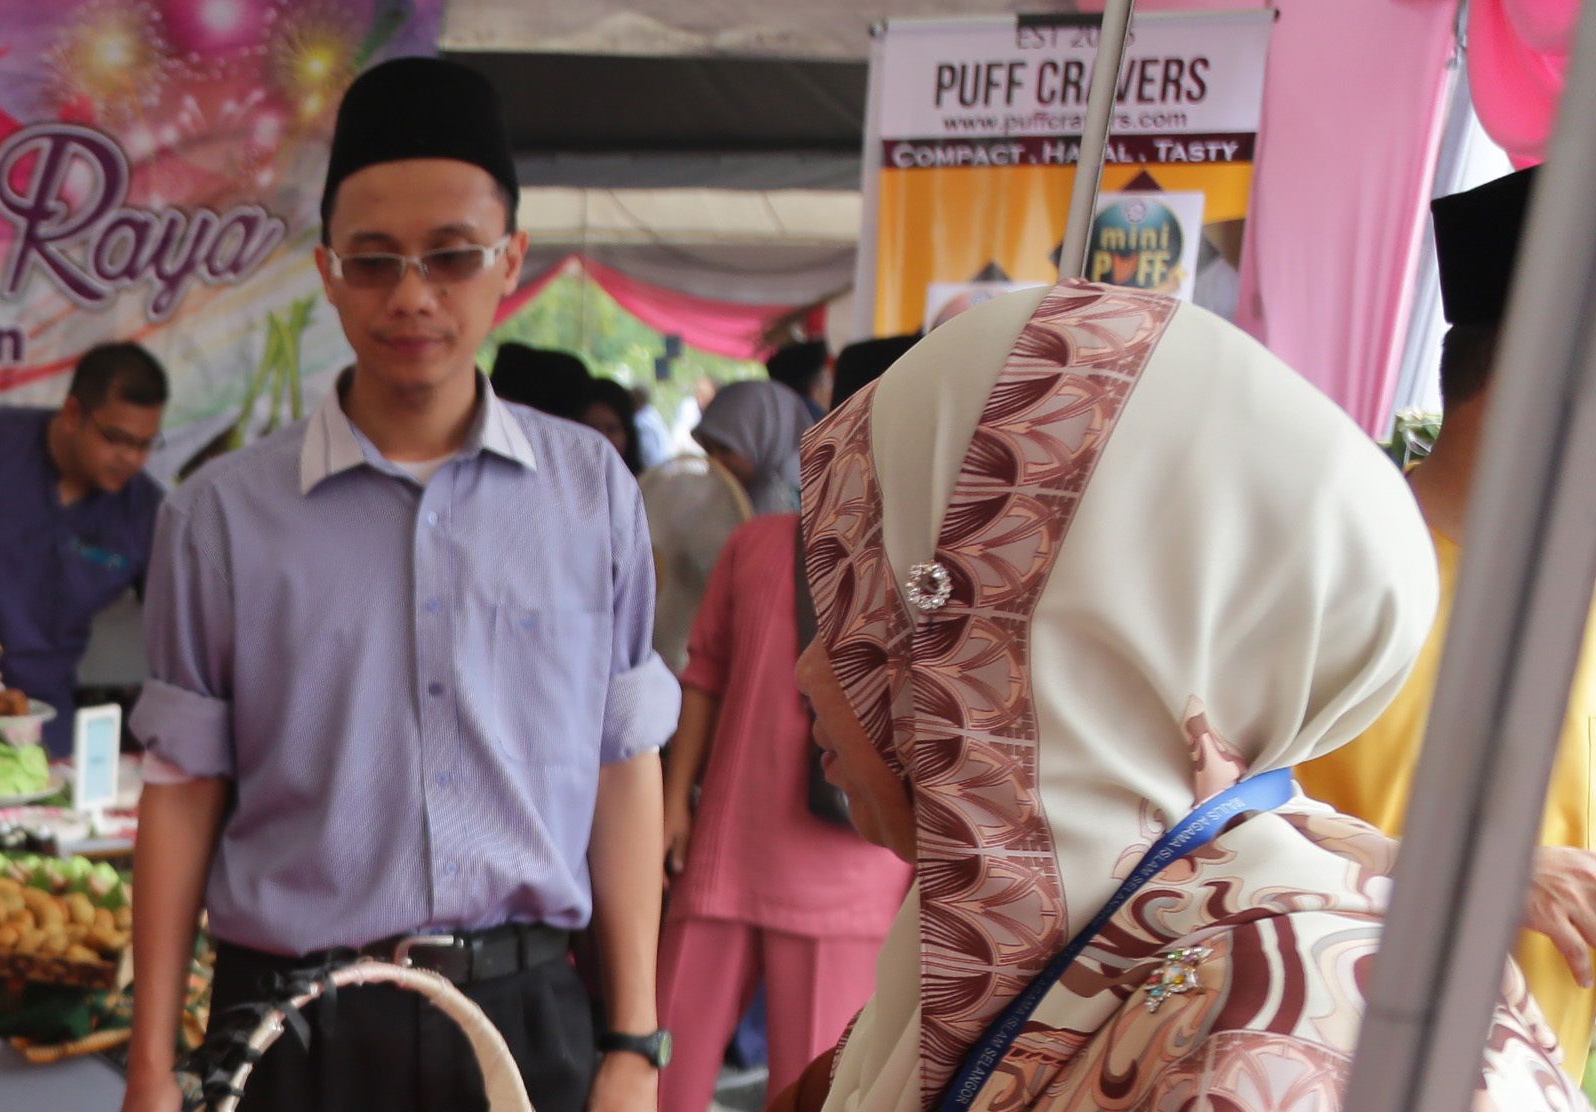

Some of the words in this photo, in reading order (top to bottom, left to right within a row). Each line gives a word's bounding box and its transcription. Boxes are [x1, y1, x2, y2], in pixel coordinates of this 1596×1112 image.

[934, 61, 1028, 108] PUFF
[1036, 56, 1211, 105] CRVERS
[1042, 141, 1134, 165] HAAL
[1152, 138, 1238, 163] TASTY
[1099, 222, 1171, 250] mini
[1171, 816, 1211, 848] AGAMA
[1140, 847, 1175, 876] ISLAM
[955, 1046, 998, 1105] SELANGOR
